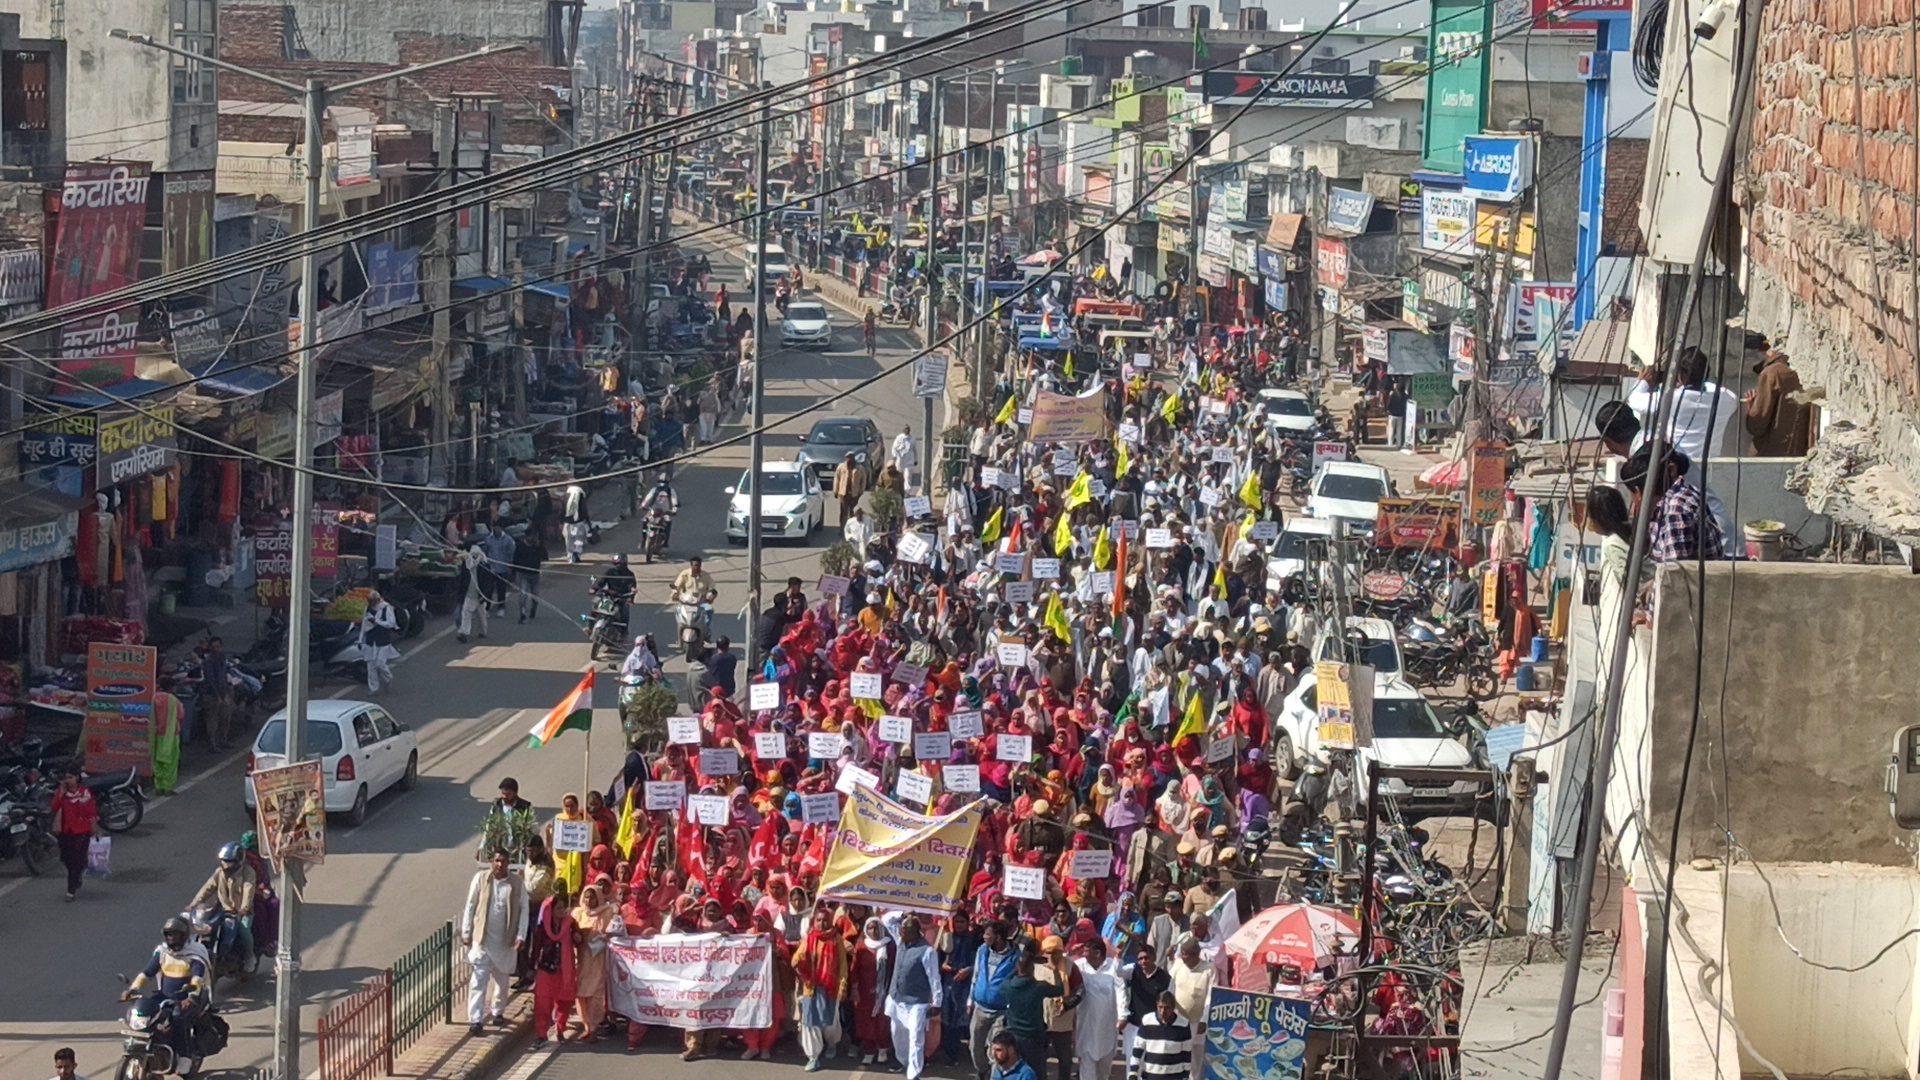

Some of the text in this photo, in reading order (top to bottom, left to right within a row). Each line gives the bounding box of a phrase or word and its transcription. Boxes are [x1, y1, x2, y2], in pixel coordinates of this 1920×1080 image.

[1260, 78, 1349, 95] YOKOHAMA
[62, 166, 150, 209] कटारिया
[62, 313, 138, 359] कटारिया
[101, 399, 175, 453] कटारिया
[22, 436, 96, 465] सूट ही सूट
[111, 446, 166, 483] एम्पोरियम
[322, 533, 335, 551] रेट
[928, 838, 972, 859] दिवस
[1211, 995, 1251, 1022] गायत्री
[1275, 1001, 1308, 1036] पैलेस
